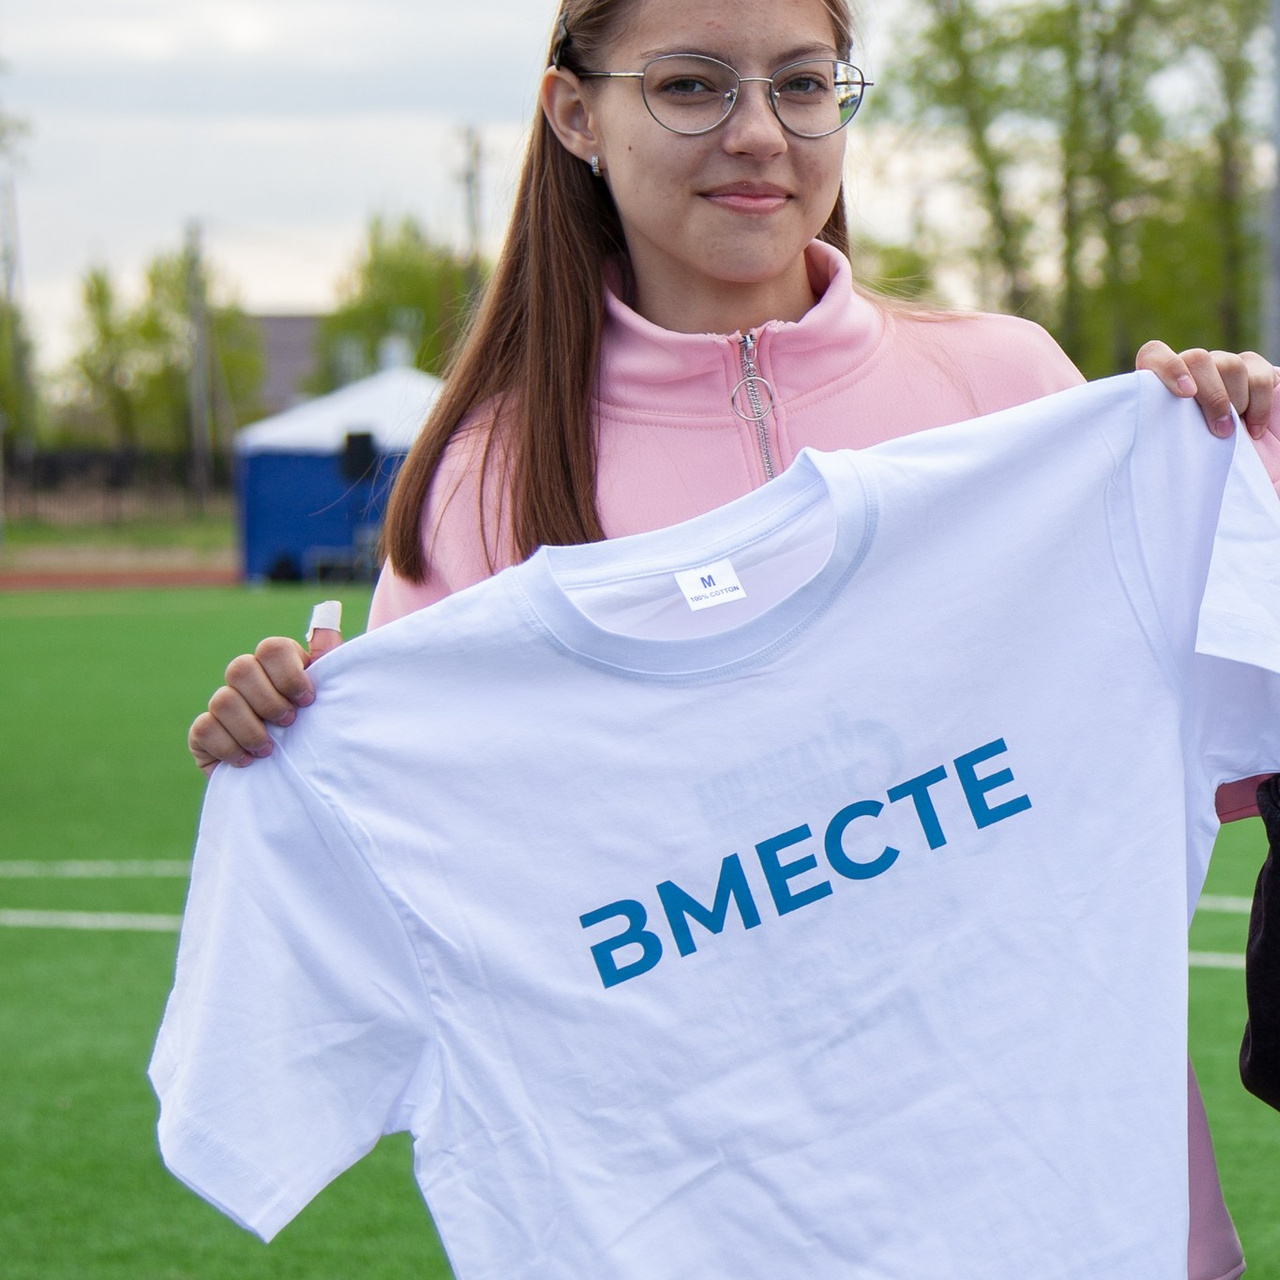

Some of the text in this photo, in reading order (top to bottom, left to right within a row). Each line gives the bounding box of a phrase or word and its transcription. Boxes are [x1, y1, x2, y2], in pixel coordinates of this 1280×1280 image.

[700, 575, 717, 589] M
[690, 585, 740, 603] 100% COTTON
[579, 737, 1032, 989] ВМЕСТЕ
